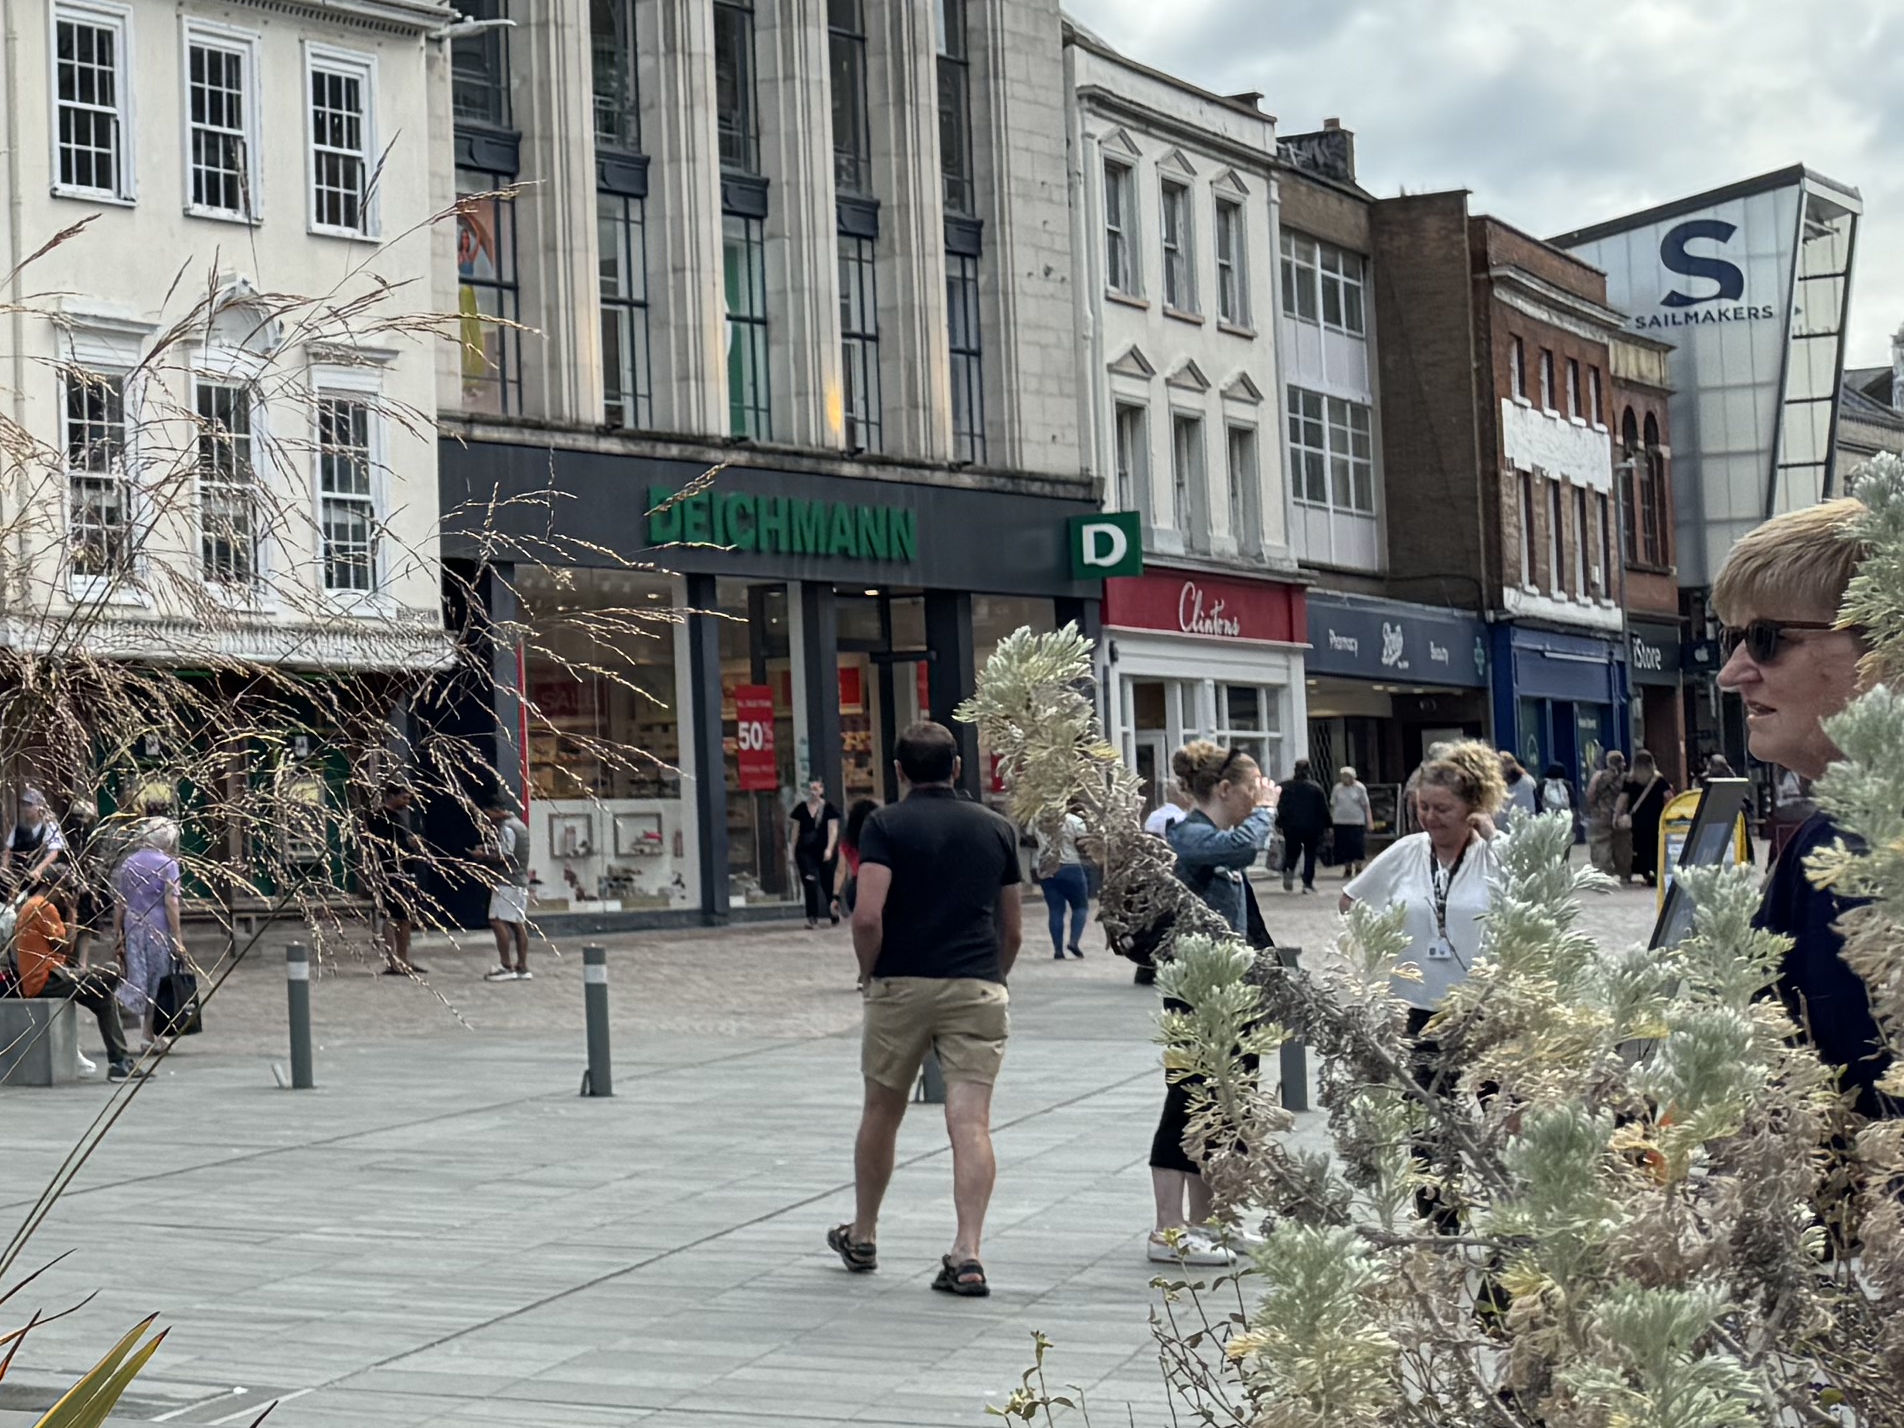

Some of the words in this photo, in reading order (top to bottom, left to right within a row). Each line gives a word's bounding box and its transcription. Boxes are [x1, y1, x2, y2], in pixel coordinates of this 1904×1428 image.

[1660, 219, 1744, 307] S
[1635, 305, 1774, 329] SAILMAKERS
[647, 484, 916, 560] DEICHMANN
[1082, 524, 1128, 567] D
[1178, 581, 1240, 637] Clintons
[1632, 637, 1661, 671] iStore
